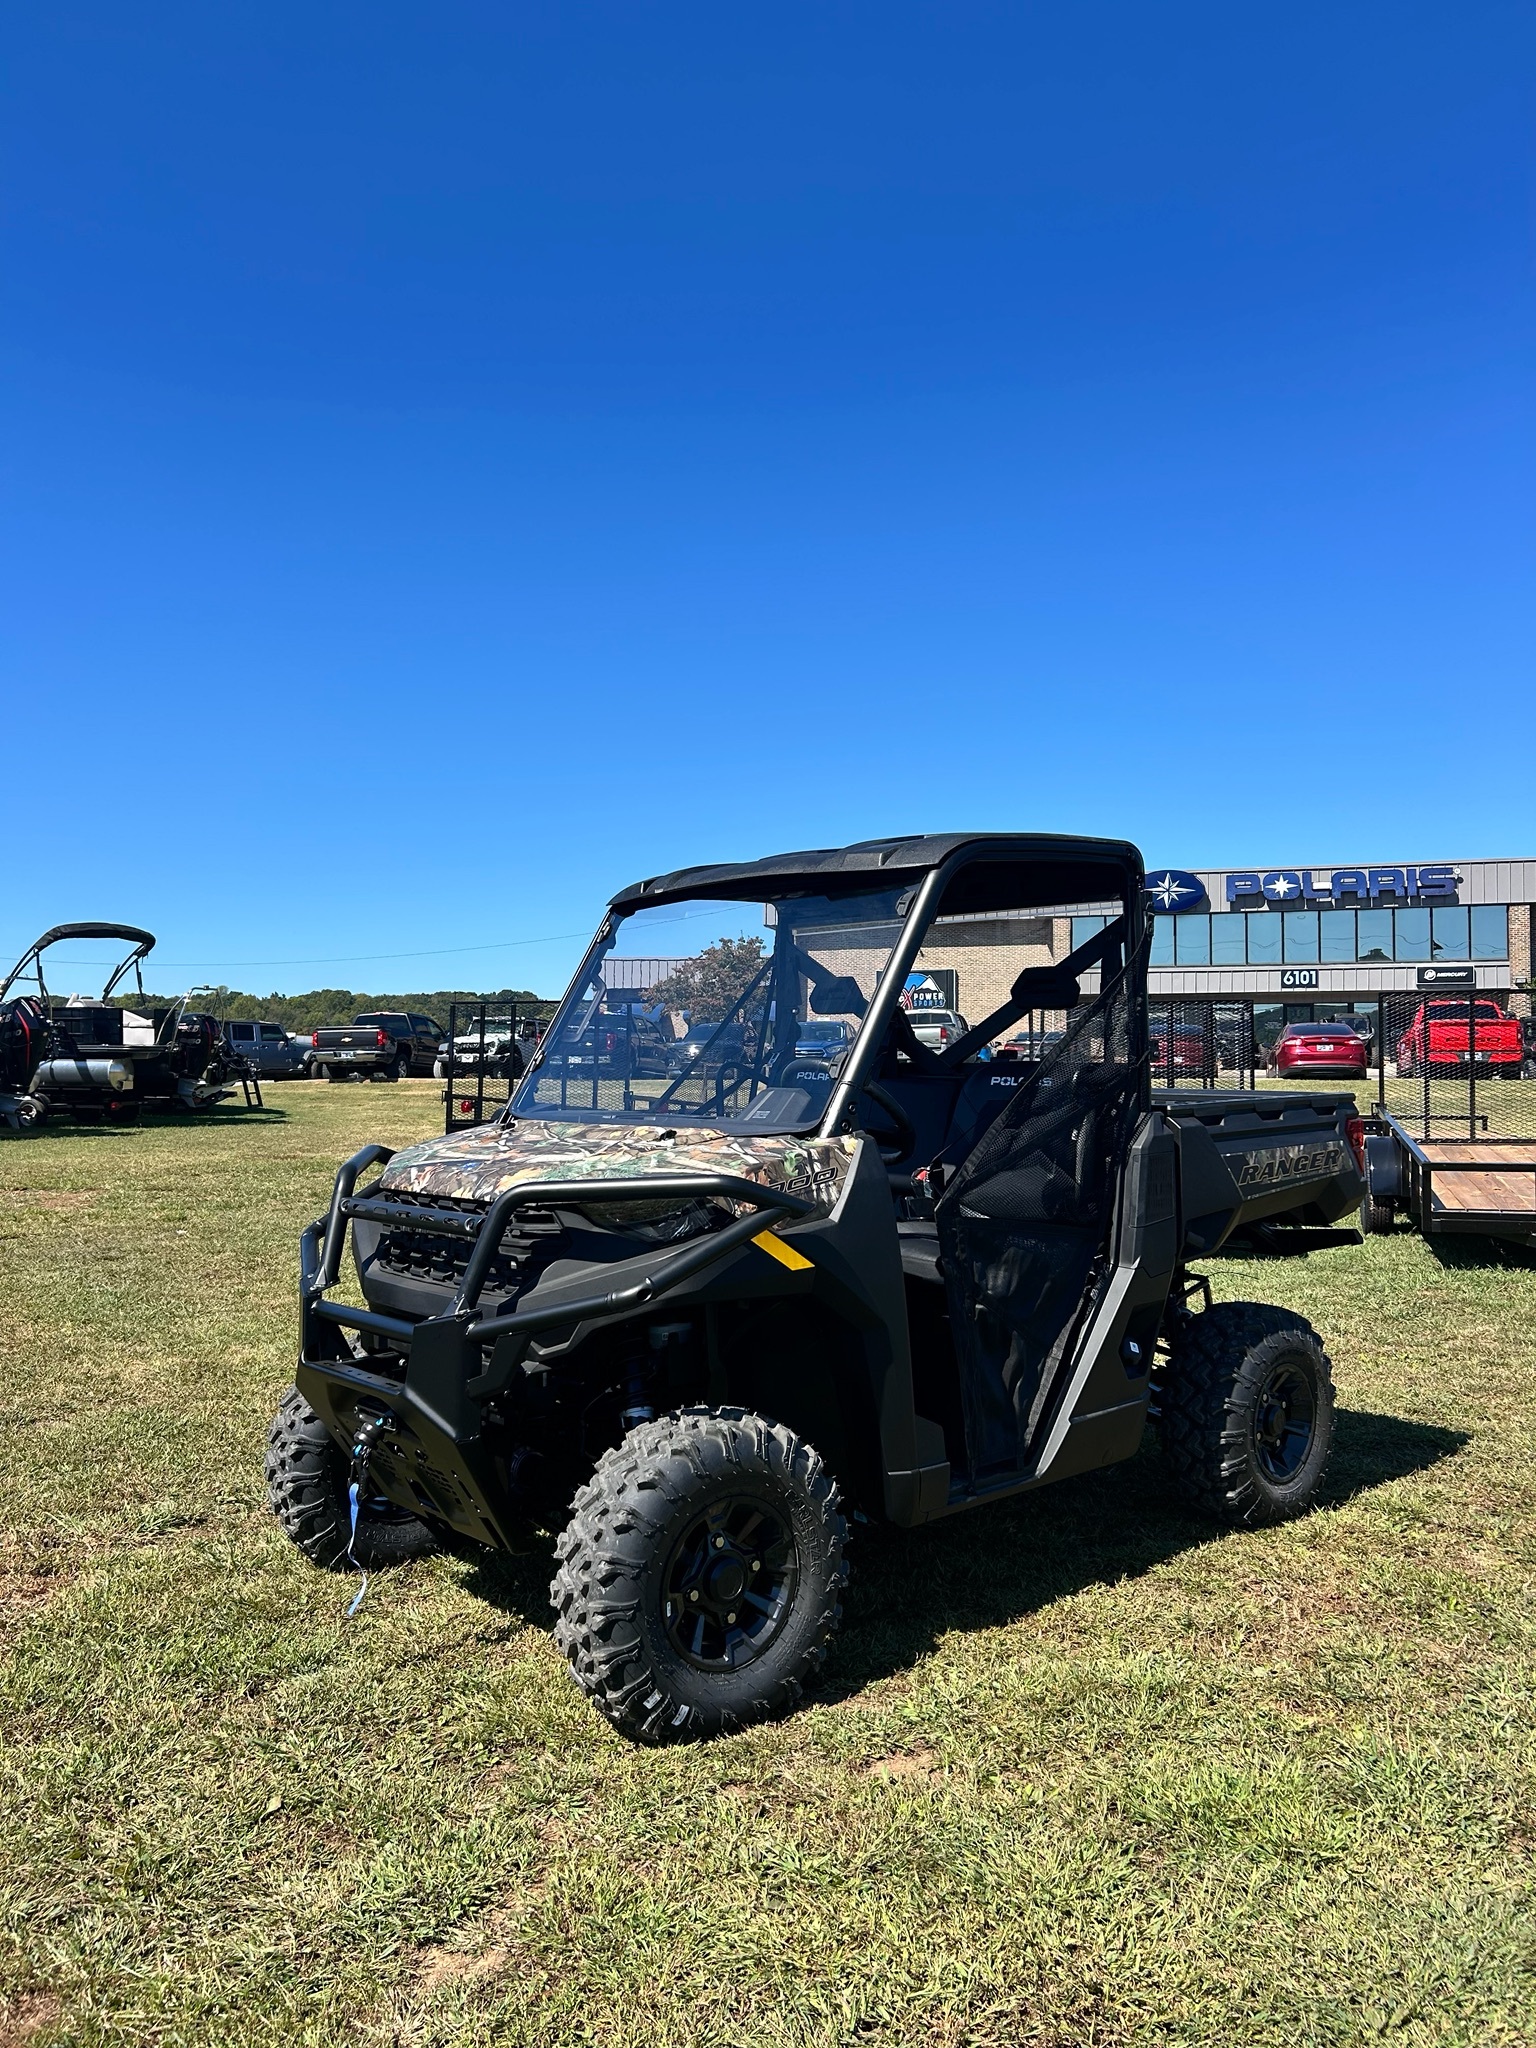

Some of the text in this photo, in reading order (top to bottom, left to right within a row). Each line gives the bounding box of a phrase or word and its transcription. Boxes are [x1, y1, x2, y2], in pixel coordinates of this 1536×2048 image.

[1226, 867, 1455, 902] POLARIS
[1283, 970, 1317, 985] 6101
[913, 992, 943, 1000] POWER
[1238, 1148, 1340, 1186] RANGER
